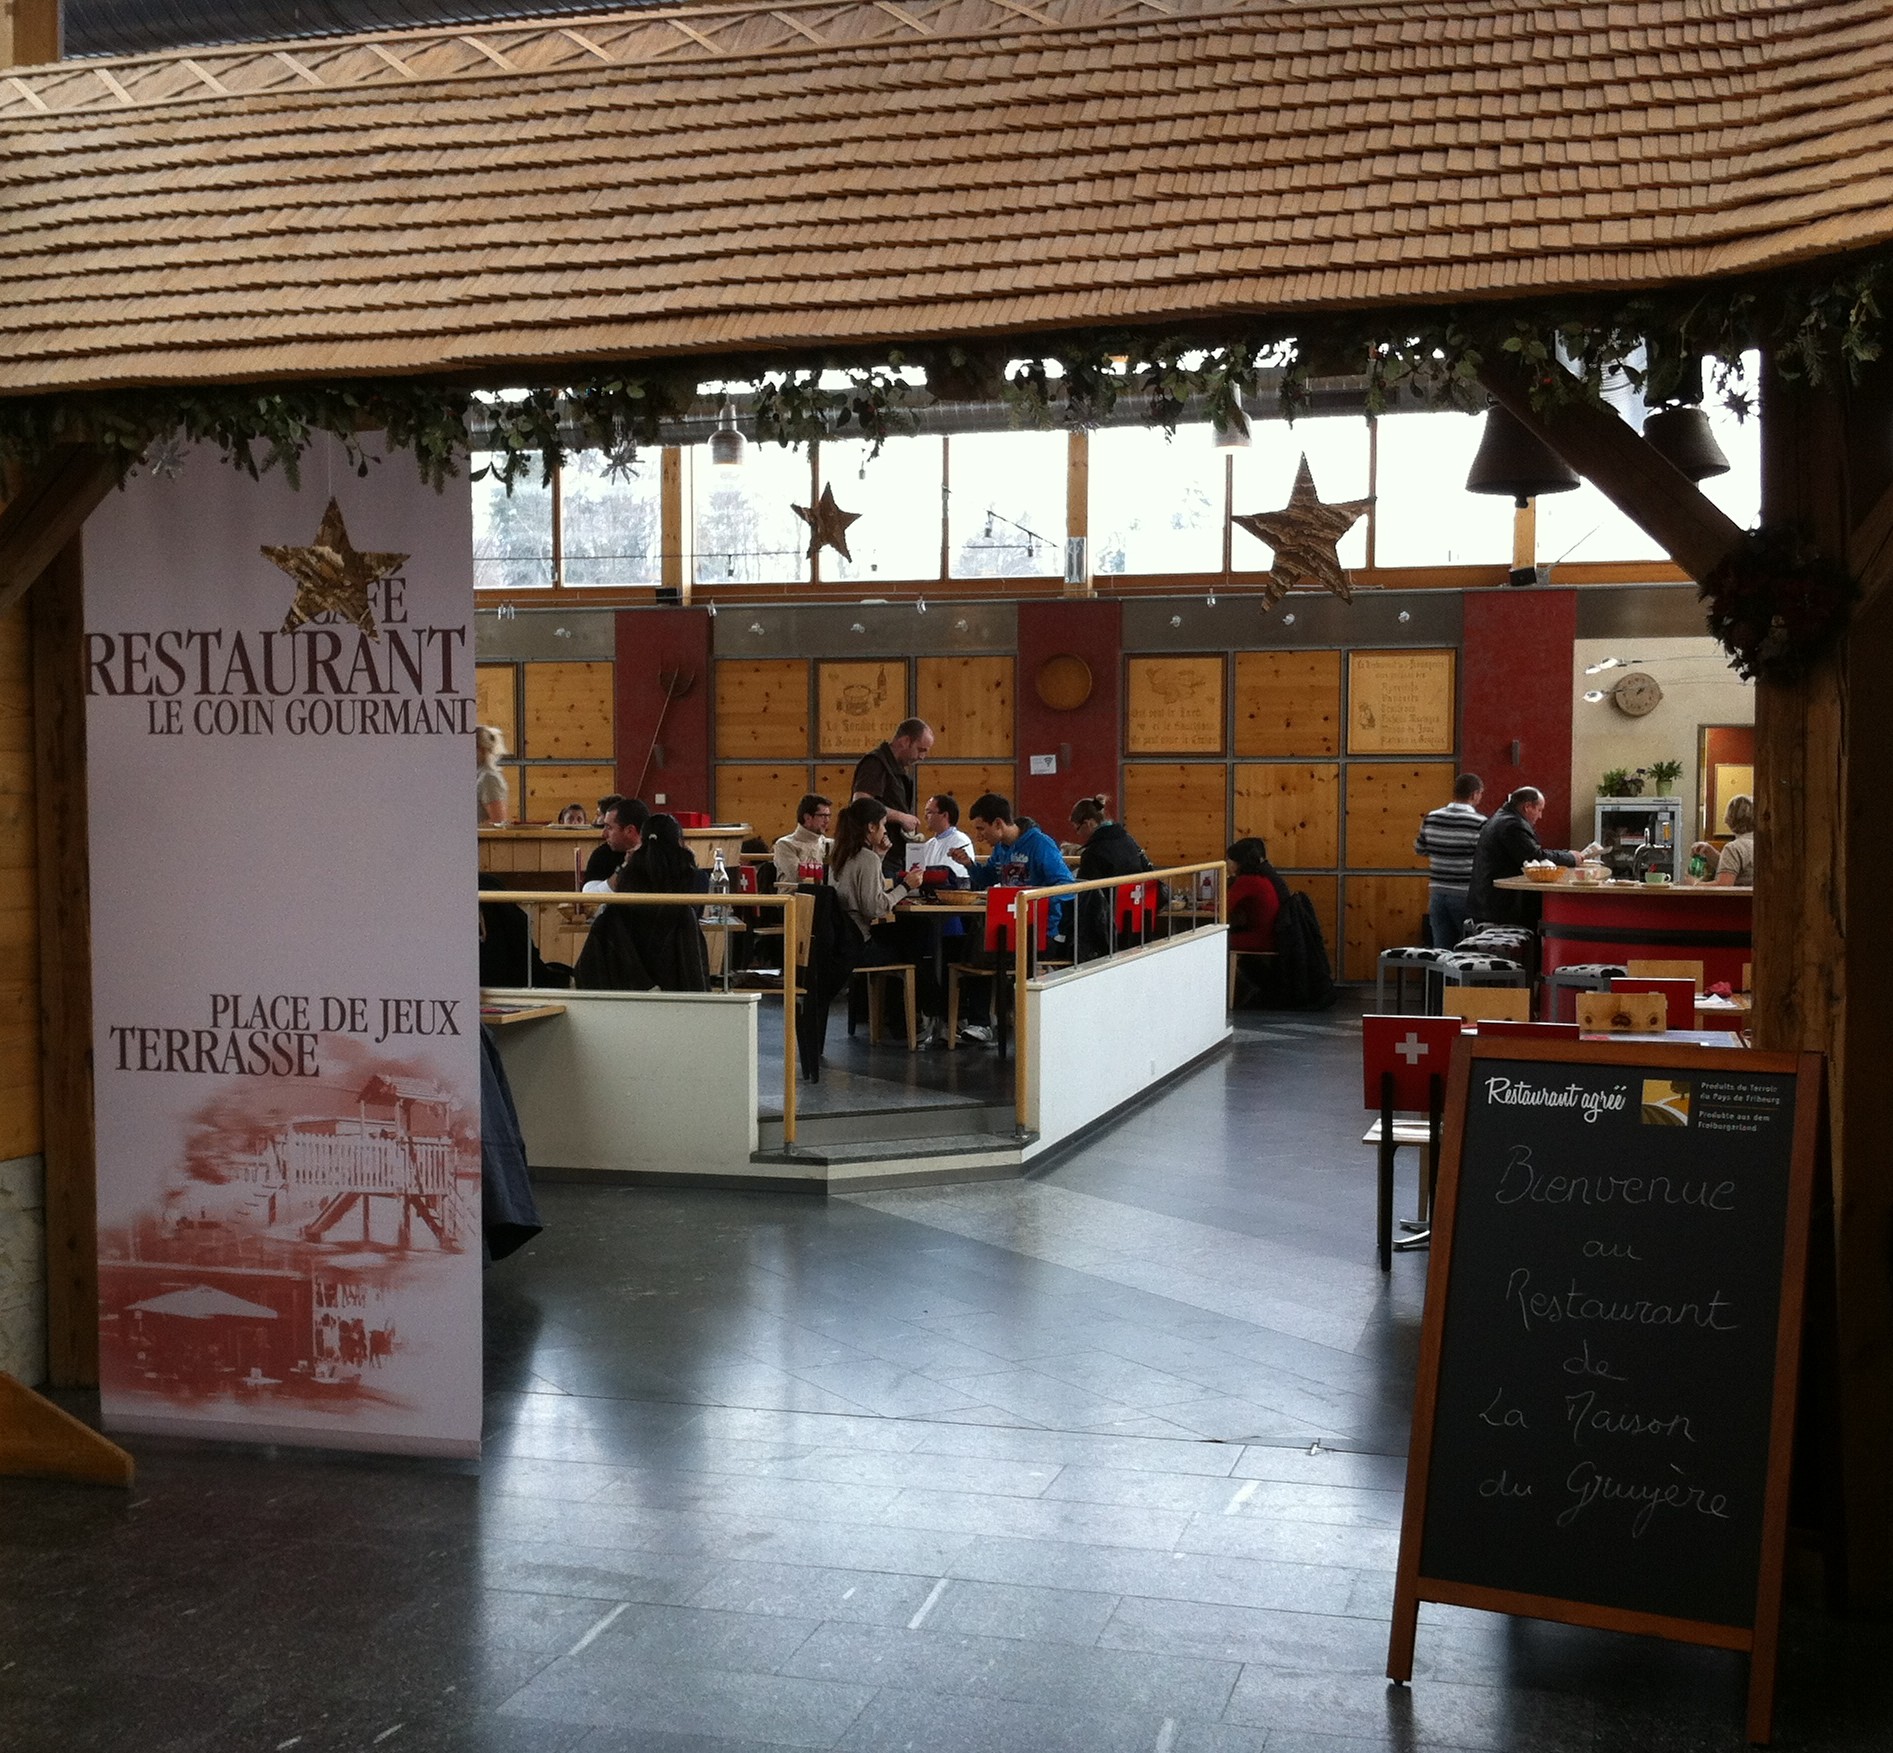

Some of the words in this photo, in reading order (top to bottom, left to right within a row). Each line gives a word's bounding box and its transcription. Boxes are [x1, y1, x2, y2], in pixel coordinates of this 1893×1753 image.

[84, 625, 466, 697] RESTAURANT
[147, 699, 184, 736] LE
[193, 699, 276, 736] COIN
[285, 698, 478, 736] GOURMAND
[209, 994, 310, 1032] PLACE
[319, 996, 369, 1034] DE
[375, 998, 462, 1044] JEUX
[109, 1024, 320, 1078] TERRASSE
[1484, 1077, 1584, 1108] Restaurant
[1495, 1144, 1736, 1211] Bienvenue
[1582, 1239, 1643, 1261] au
[1505, 1267, 1738, 1332] Restaurant
[1562, 1338, 1630, 1382] de
[1478, 1386, 1529, 1429] La
[1564, 1390, 1697, 1447] Maison
[1478, 1469, 1533, 1498] du
[1556, 1460, 1731, 1539] Gruyère
